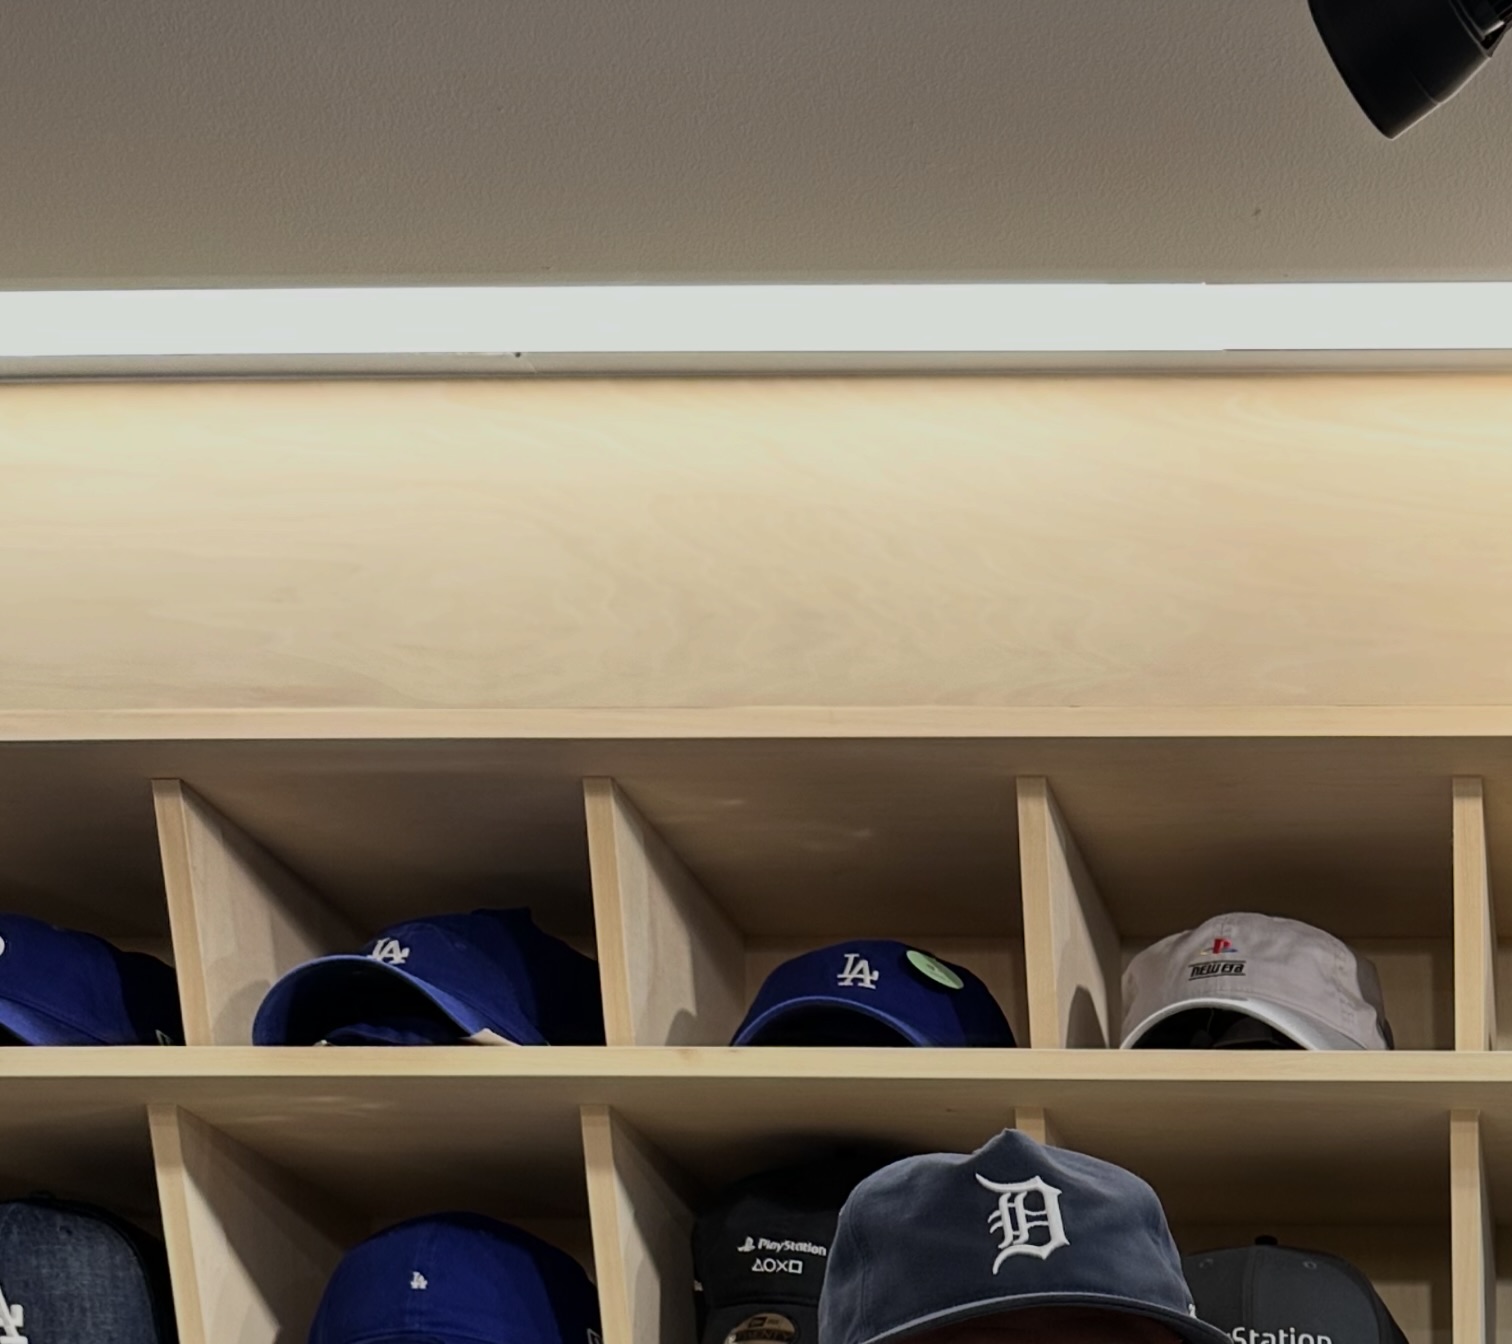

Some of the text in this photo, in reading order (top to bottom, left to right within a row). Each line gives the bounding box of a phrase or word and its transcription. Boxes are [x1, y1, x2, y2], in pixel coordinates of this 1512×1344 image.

[837, 952, 880, 991] LA
[975, 1173, 1069, 1275] D
[757, 1237, 828, 1257] PlayStation
